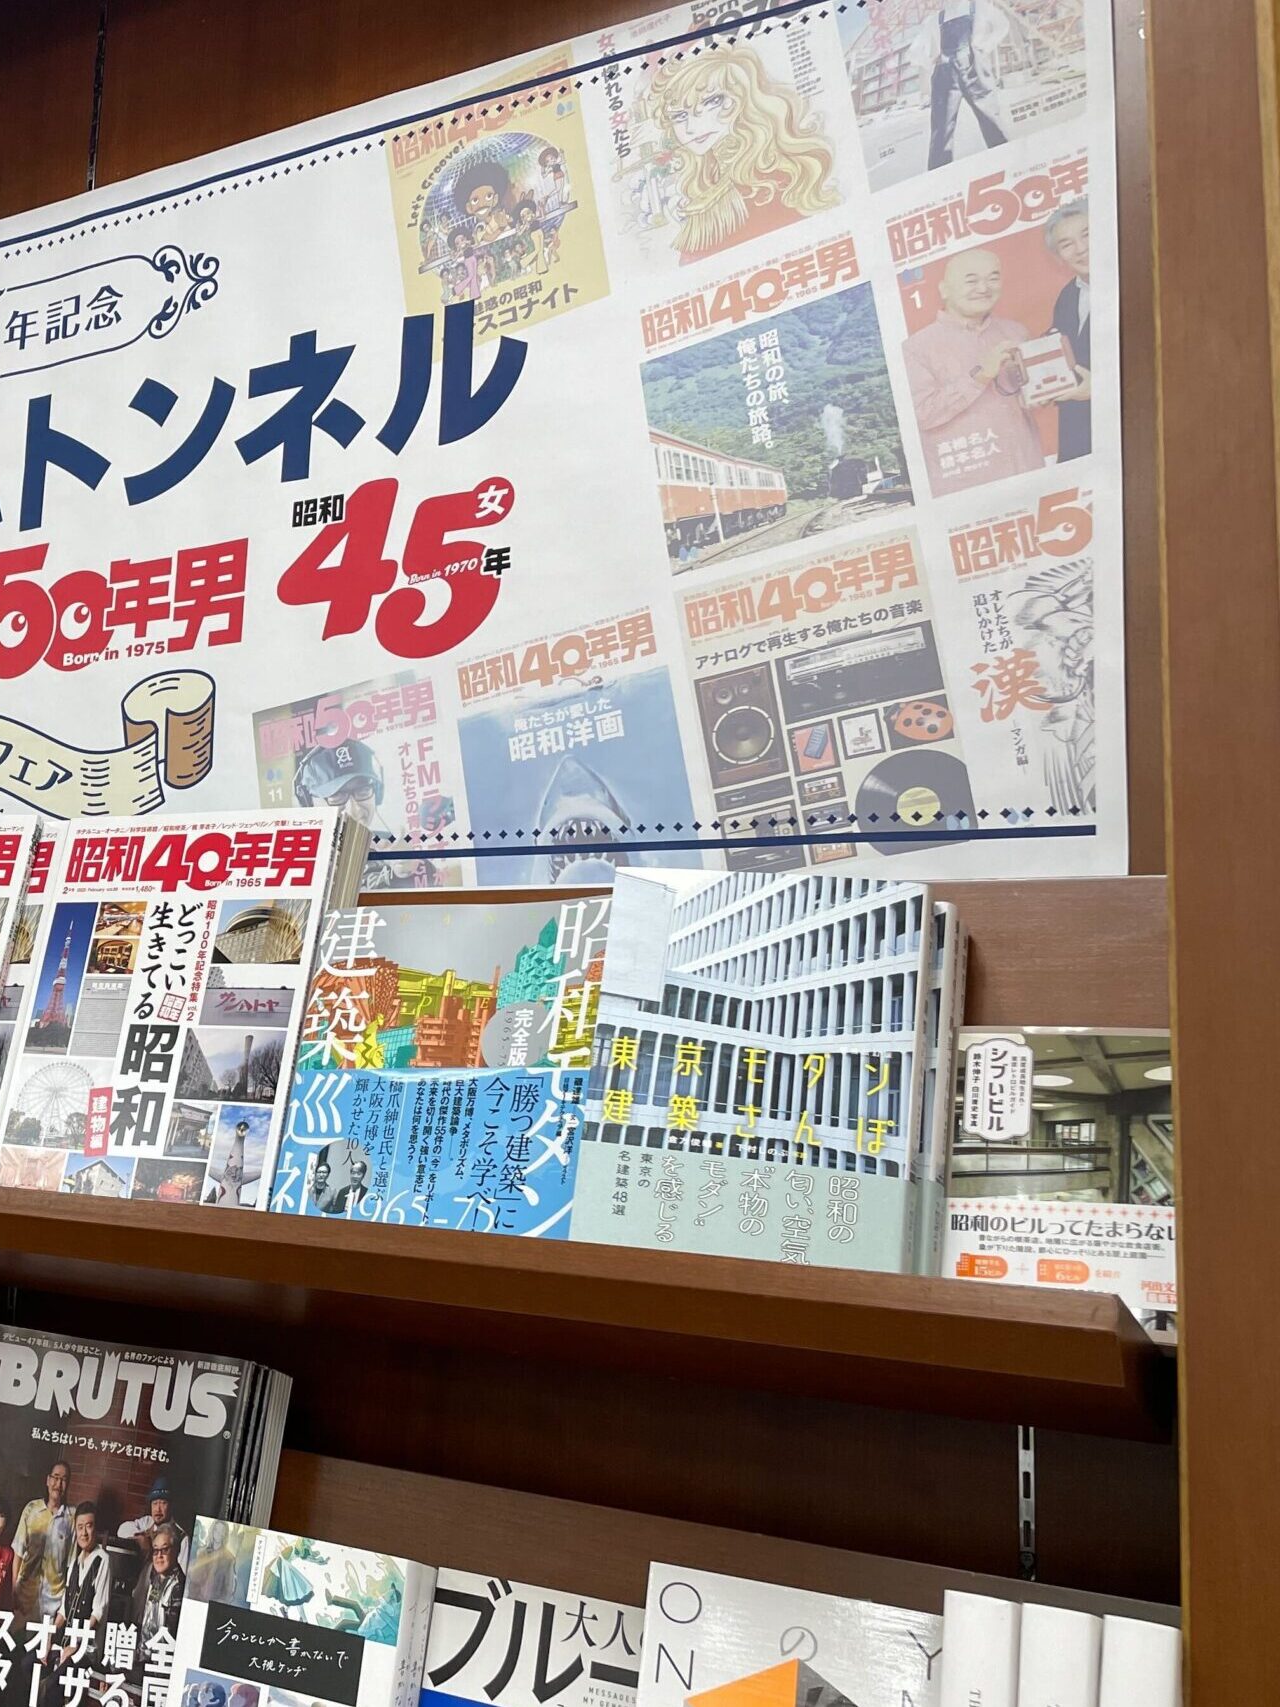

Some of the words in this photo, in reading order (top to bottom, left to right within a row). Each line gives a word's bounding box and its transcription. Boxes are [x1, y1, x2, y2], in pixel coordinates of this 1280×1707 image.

[641, 237, 860, 348] 昭和40年男
[293, 493, 345, 527] 昭和
[476, 484, 510, 518] 女
[276, 477, 504, 659] 45
[443, 557, 478, 578] 1970
[483, 547, 511, 578] 年
[684, 542, 918, 638] 昭和40年男
[63, 649, 100, 667] Born
[104, 647, 118, 661] in
[125, 641, 165, 659] 1975
[457, 612, 657, 702] 昭和40年男
[696, 599, 923, 669] アナログで再生する俺たちの音楽
[970, 648, 1054, 723] 漢
[508, 711, 625, 763] 昭和洋画
[65, 829, 322, 893] 昭和40年男
[236, 877, 261, 888] 1965
[133, 901, 174, 1020] 生きてる
[165, 903, 203, 992] どっこい
[189, 900, 218, 1003] 昭和100年記念特集
[186, 1011, 195, 1022] 2
[507, 1008, 535, 1067] 完全版
[109, 1024, 181, 1147] 昭和
[608, 1035, 890, 1097] 東京モダン
[987, 1047, 1009, 1132] シブいビル
[342, 1078, 370, 1167] 輝かせた10人
[362, 1076, 387, 1157] 大阪万博を
[601, 1088, 898, 1155] 建築さんぽ
[494, 1076, 545, 1230] 「勝つ建築」に
[654, 1154, 686, 1243] を感じる
[780, 1169, 814, 1266] 匂い、空気
[826, 1175, 861, 1245] 昭和の
[31, 1426, 170, 1464] 私たちはいつも、サザンを口ずさむ。
[216, 1618, 351, 1670] 今のことしか書かないで
[427, 1578, 640, 1702] ブルー
